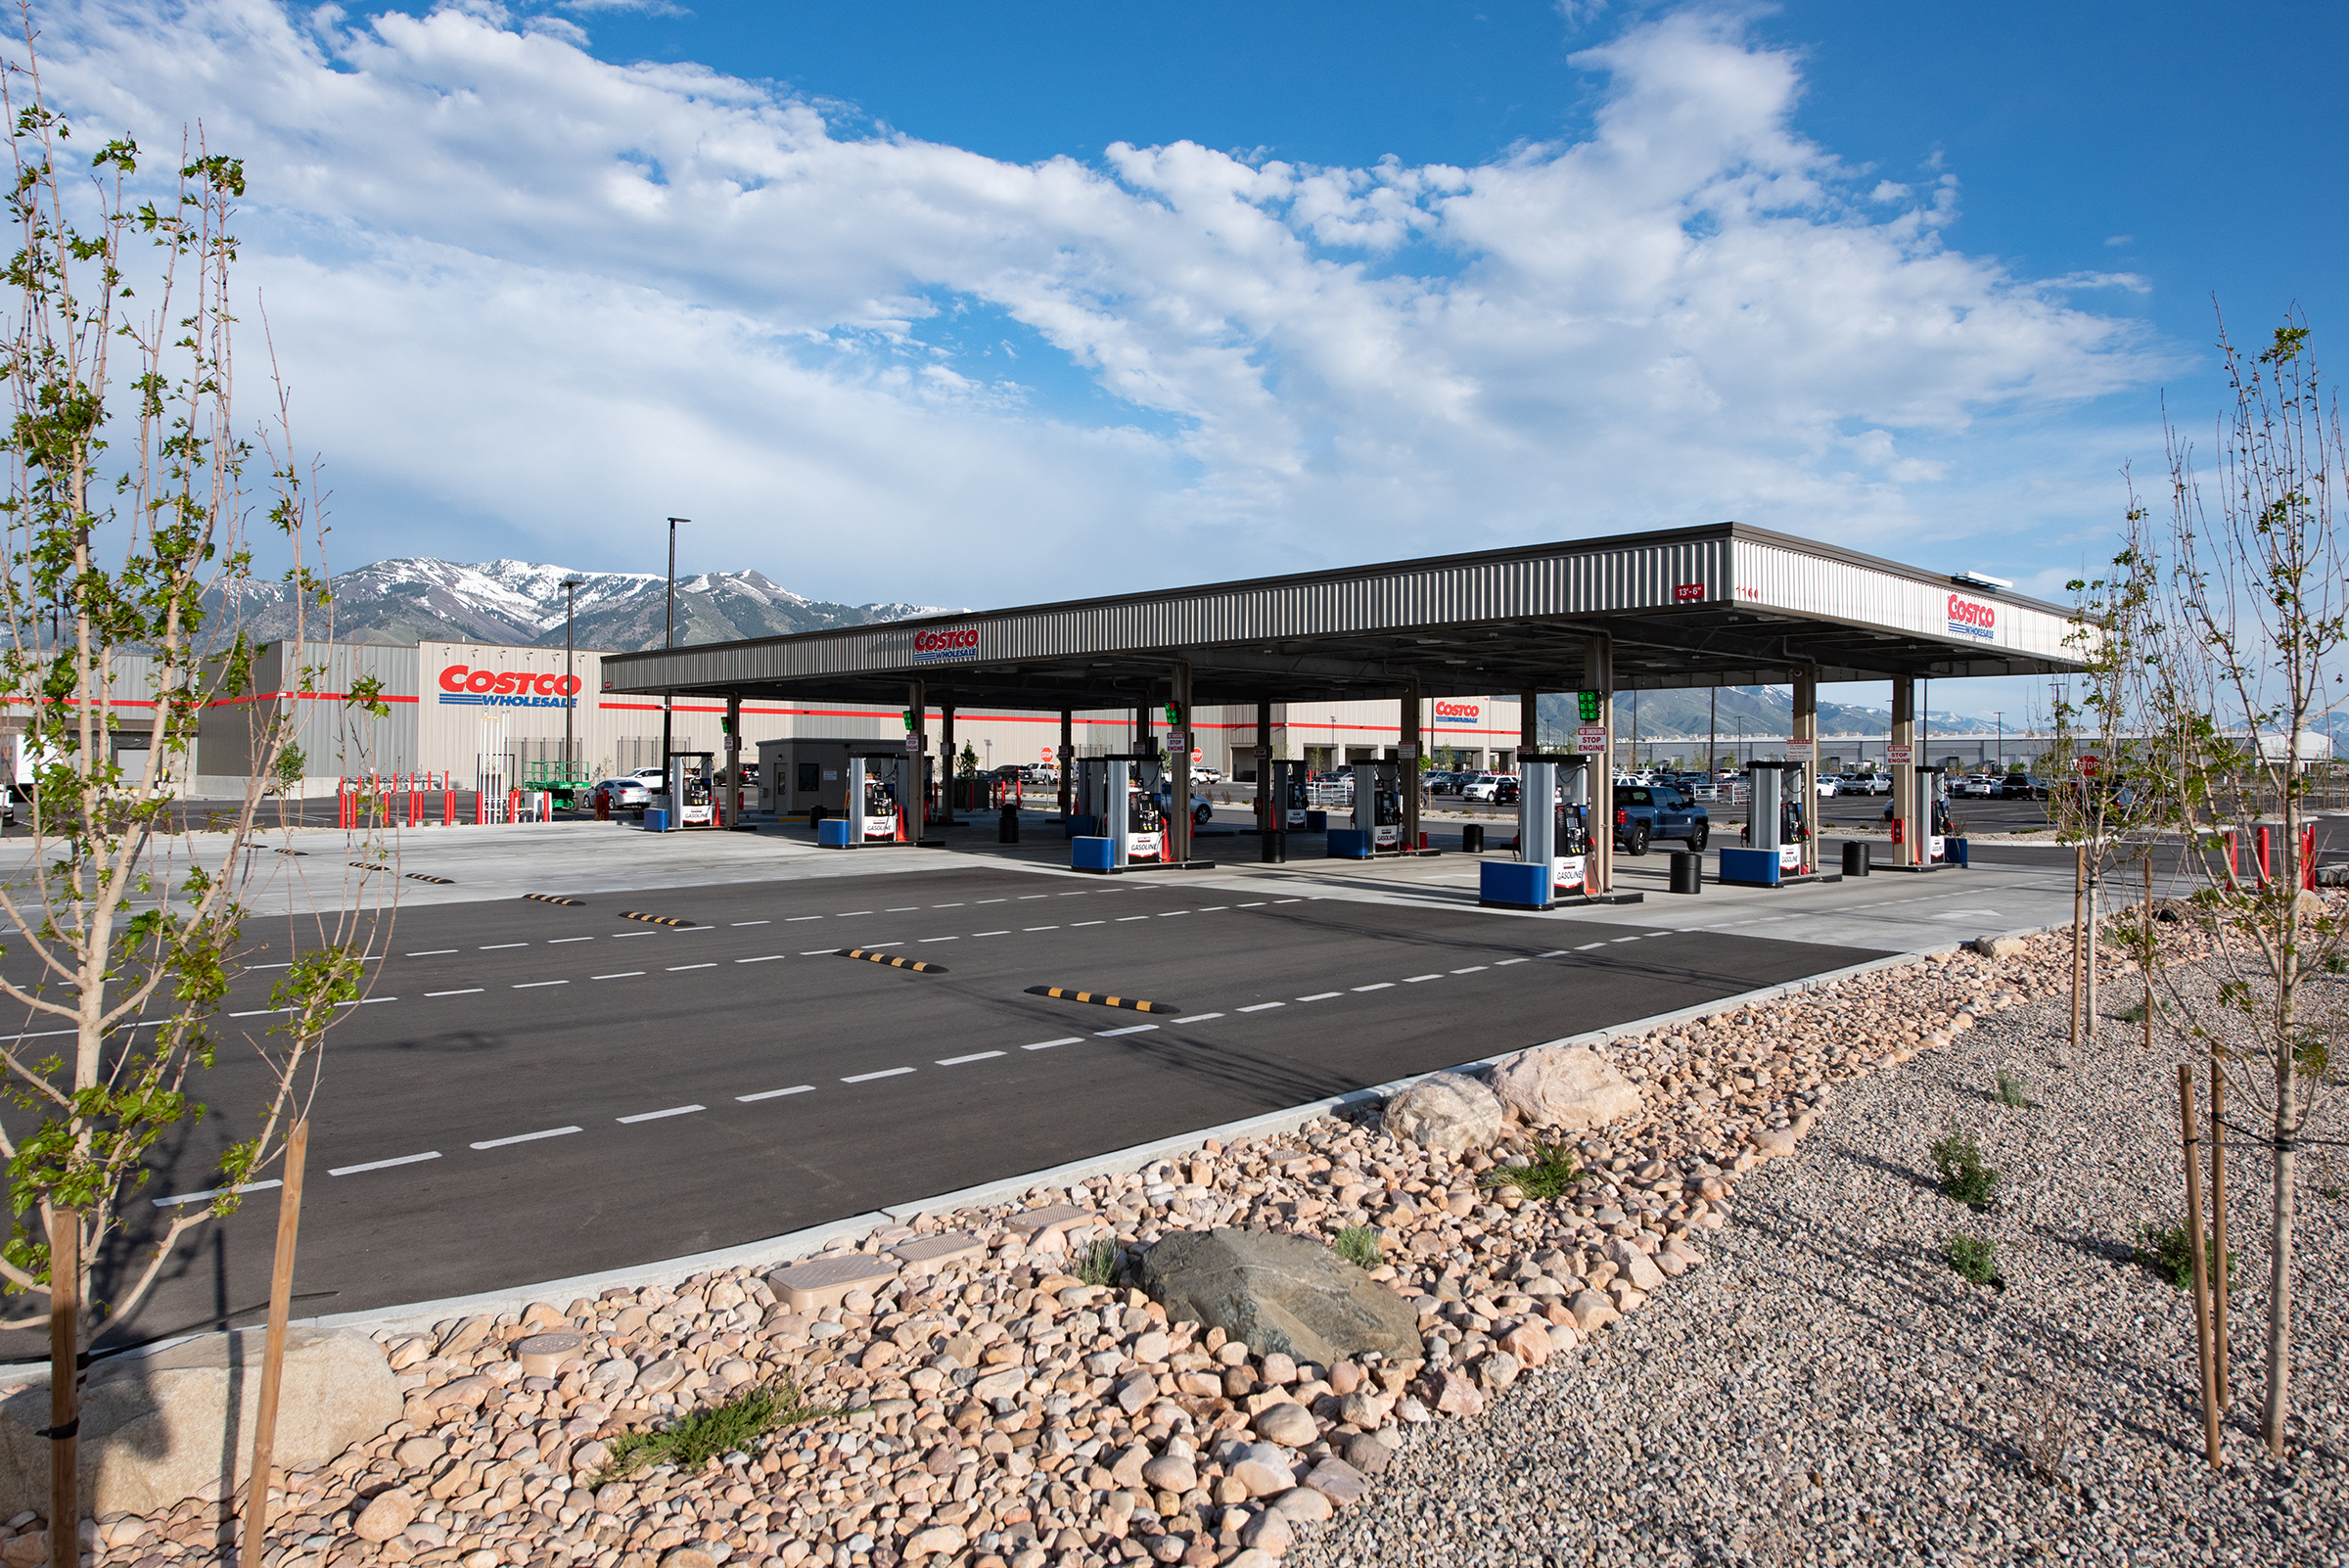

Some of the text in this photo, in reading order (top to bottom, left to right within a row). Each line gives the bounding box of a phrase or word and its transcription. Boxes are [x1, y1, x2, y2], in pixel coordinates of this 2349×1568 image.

[1948, 593, 1995, 628] COSTCO
[1965, 625, 1995, 639] WHOLESALE
[914, 628, 979, 652] COSTCO
[935, 647, 977, 659] WHOLESALE
[438, 664, 582, 696] COSTCO
[482, 694, 578, 708] WHOLESALE
[1435, 700, 1480, 717] COSTCO
[2078, 761, 2100, 770] STOP
[1556, 870, 1583, 880] GASOLINE
